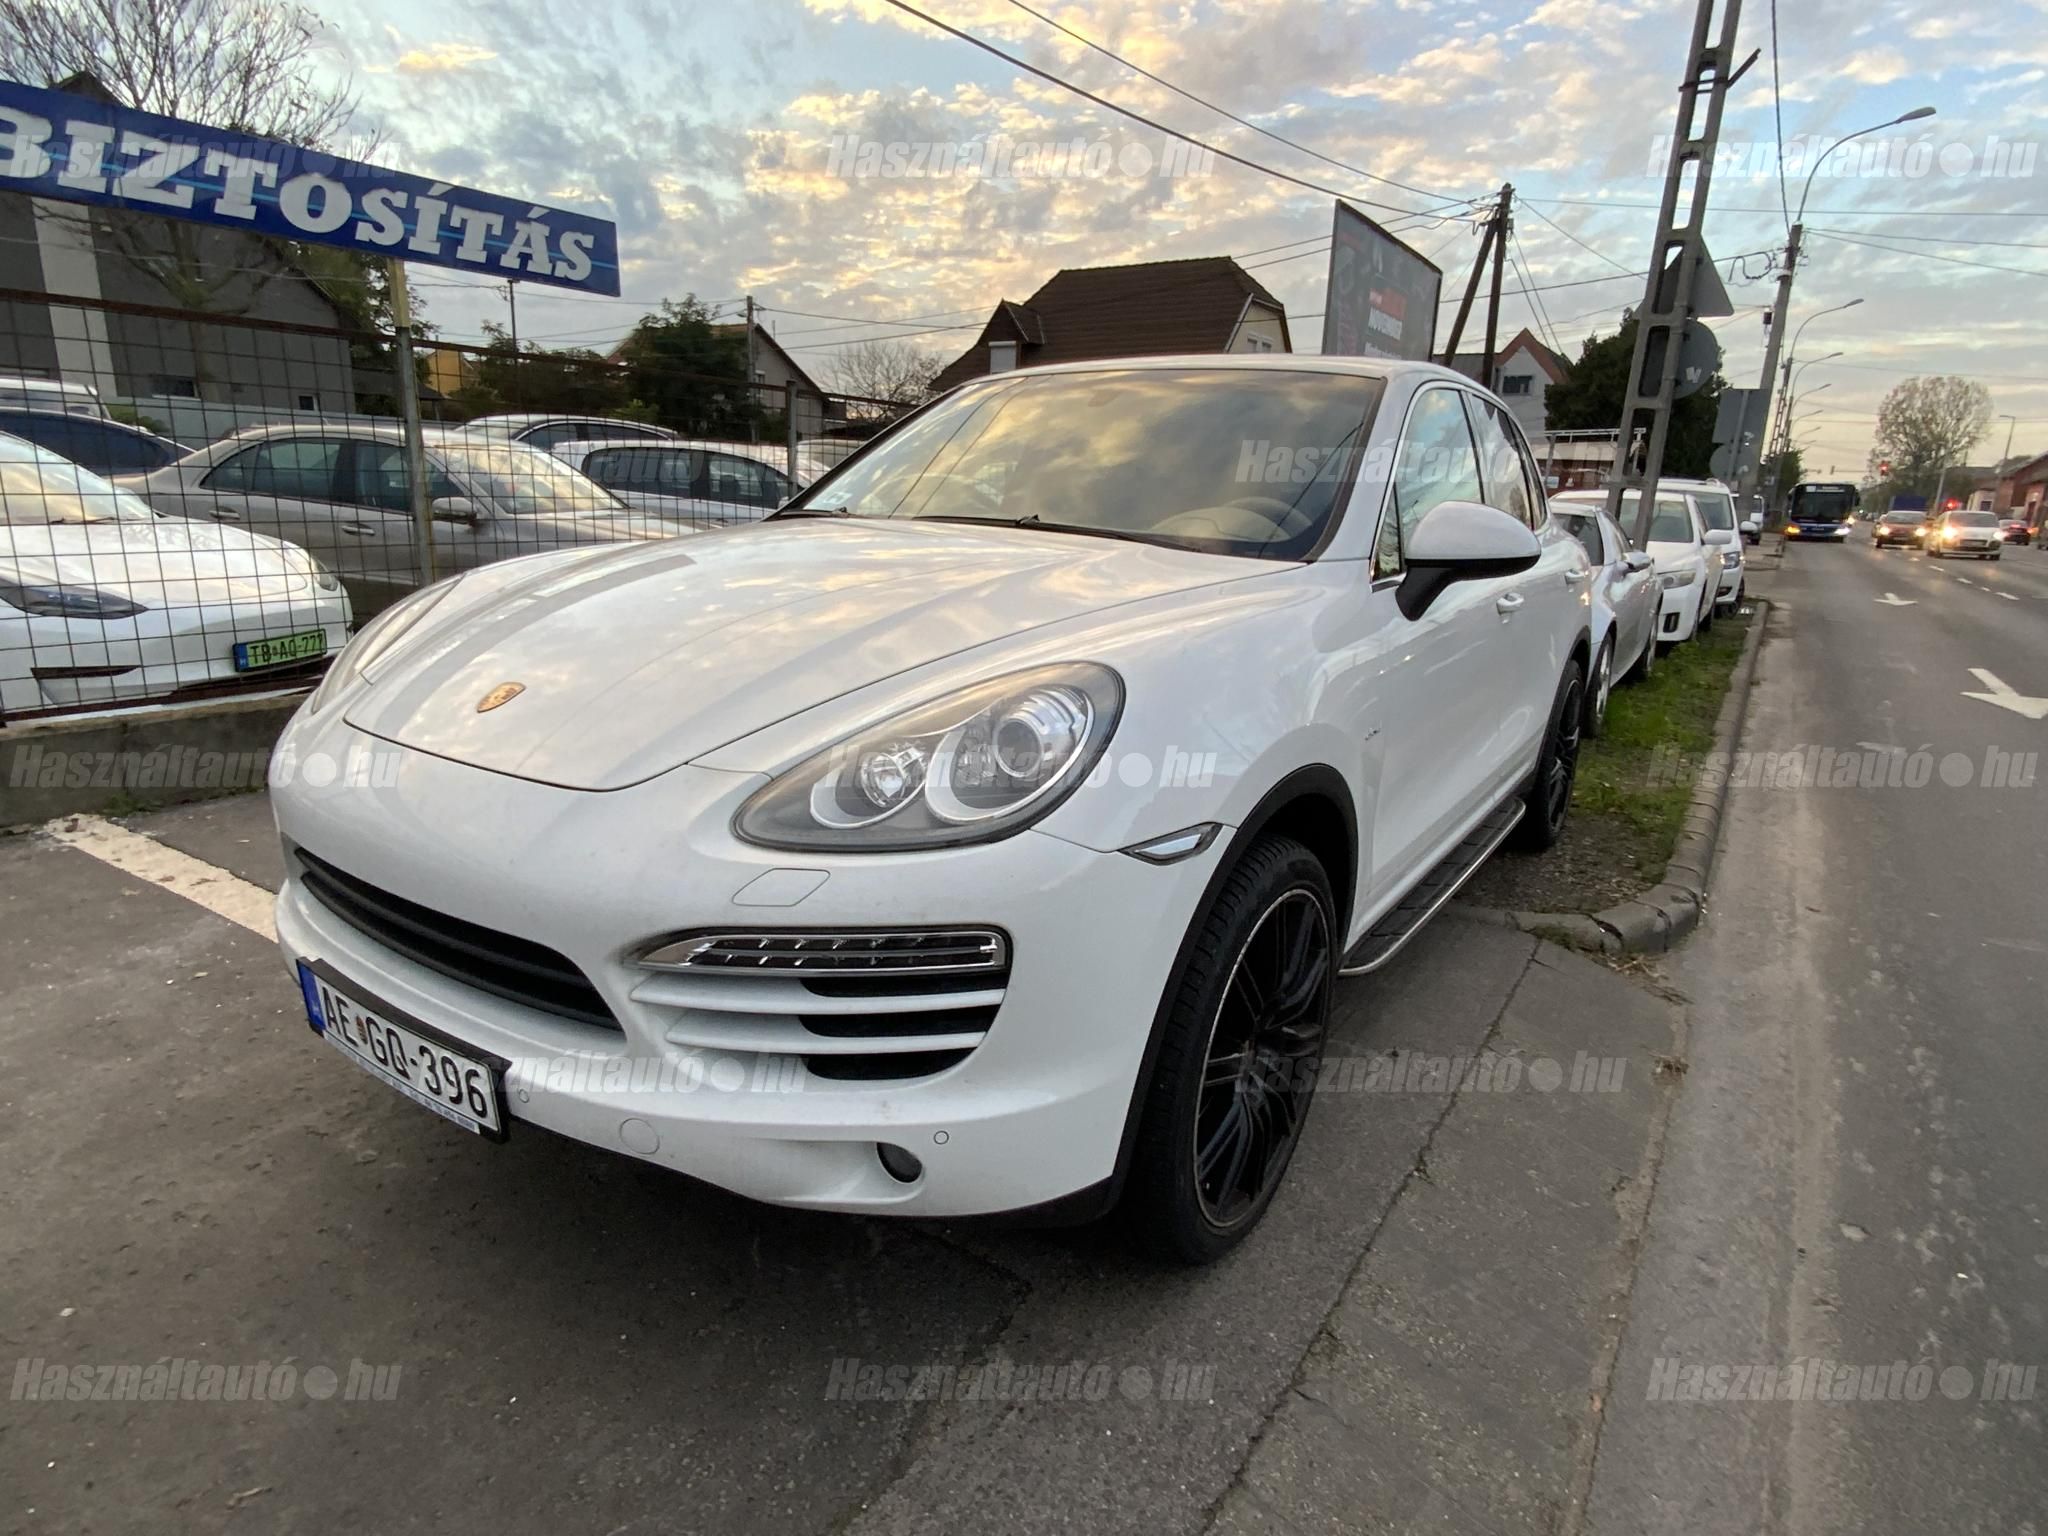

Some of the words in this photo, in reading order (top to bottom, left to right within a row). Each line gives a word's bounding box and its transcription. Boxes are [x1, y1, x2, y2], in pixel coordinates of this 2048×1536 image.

[0, 107, 595, 282] BIZTOSÍTÁS
[322, 986, 359, 1047] AE
[366, 1016, 488, 1119] GQ-396
